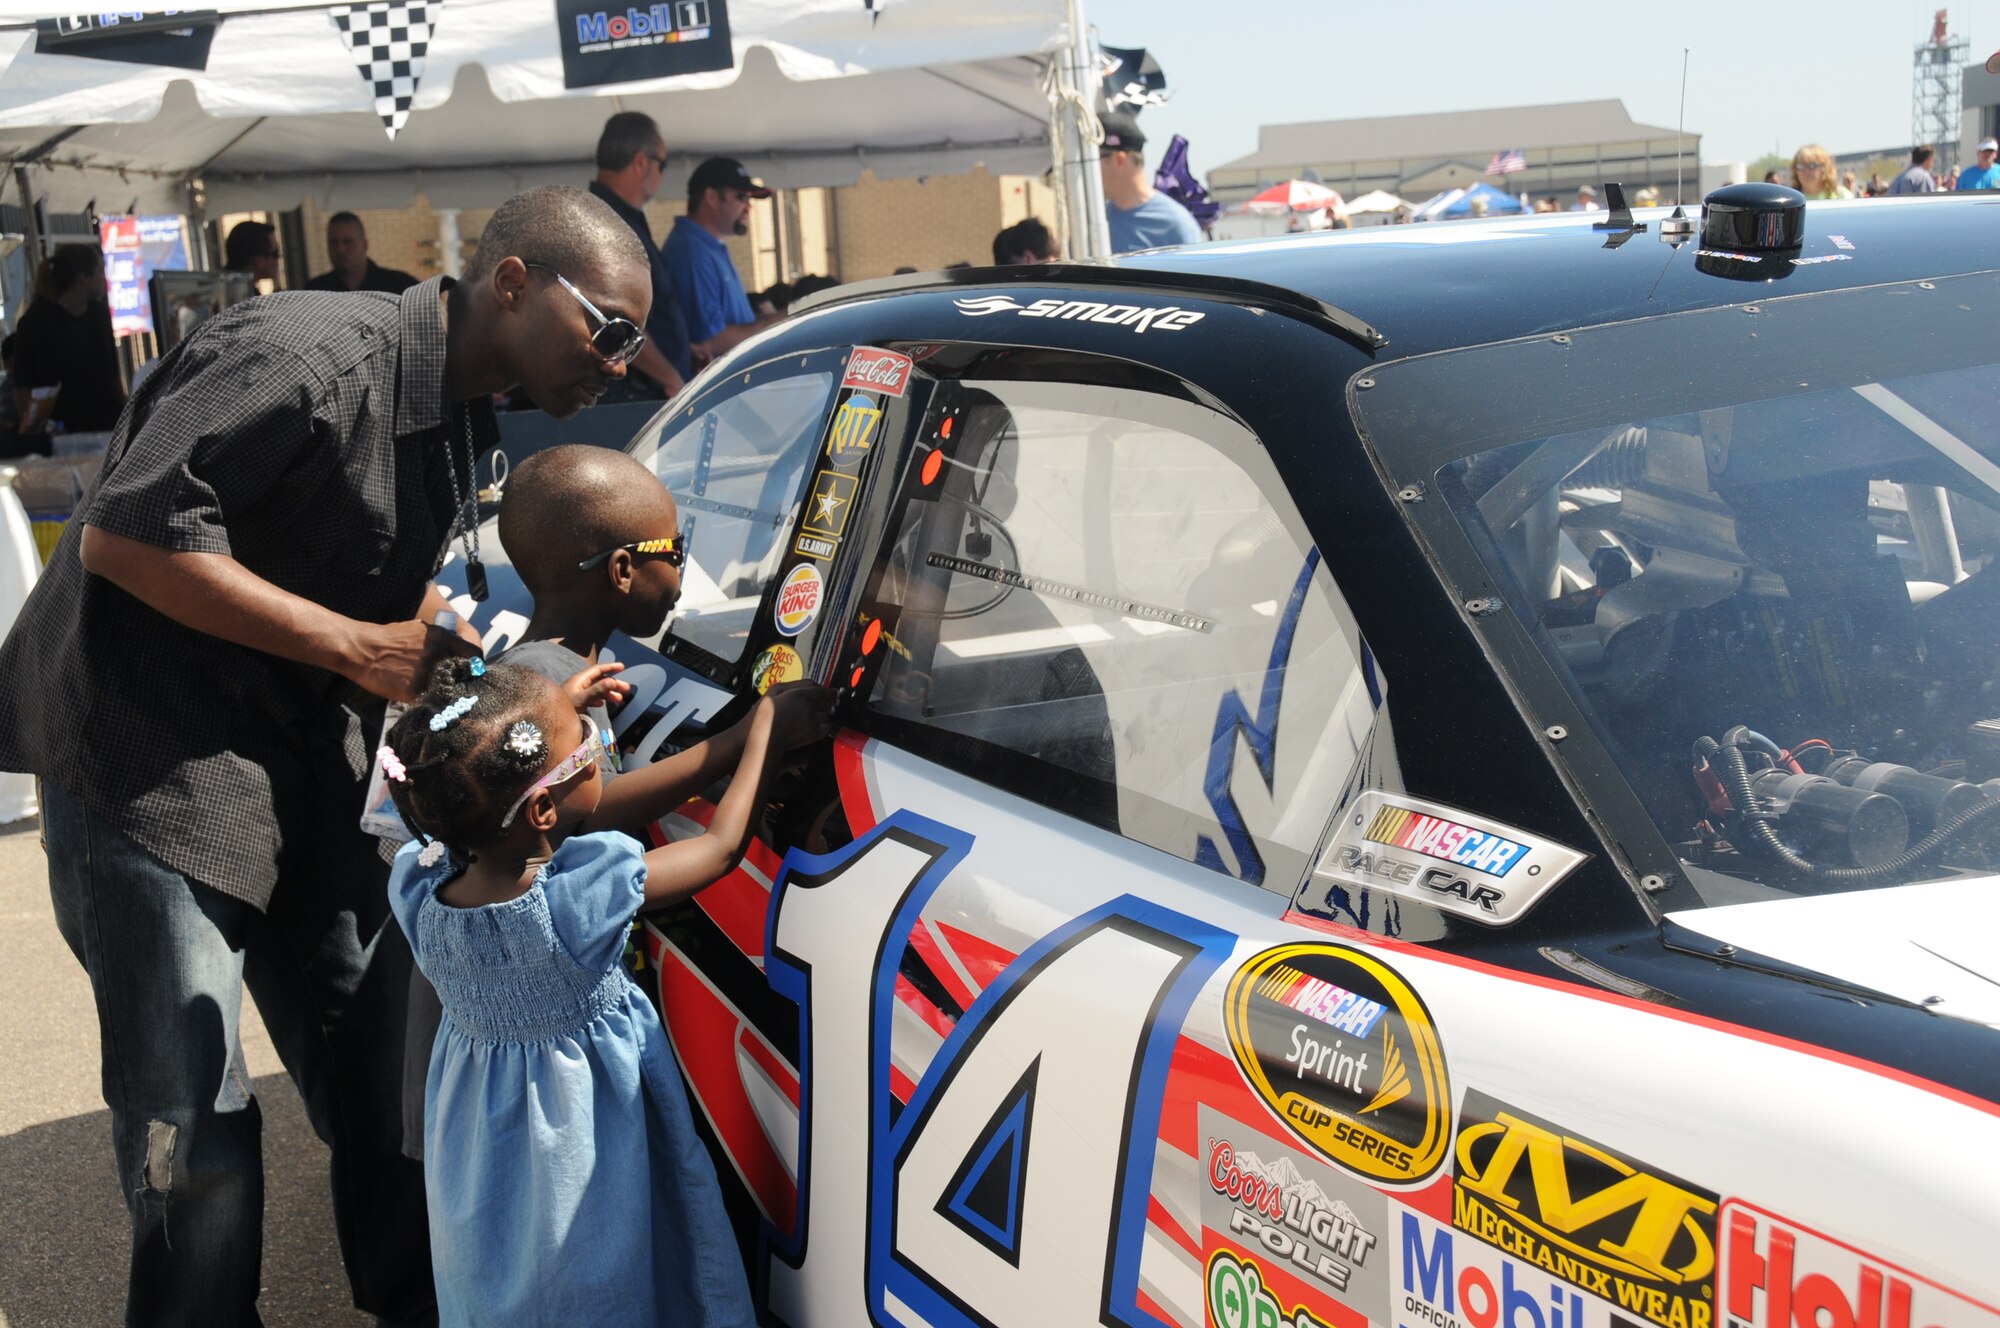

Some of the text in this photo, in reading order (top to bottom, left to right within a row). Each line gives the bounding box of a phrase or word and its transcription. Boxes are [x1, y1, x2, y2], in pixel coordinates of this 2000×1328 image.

[576, 3, 671, 43] Mobil
[847, 353, 907, 387] Coca-Cola
[826, 403, 881, 456] RITZ
[778, 594, 817, 617] KING
[783, 581, 819, 599] BURGER
[769, 663, 785, 677] Pro
[772, 647, 795, 664] Bass
[1403, 815, 1518, 874] NASCAR
[1329, 845, 1505, 916] RACE CAR
[1290, 978, 1380, 1038] NASCAR
[756, 808, 1239, 1328] 14
[1285, 1024, 1368, 1094] Sprint
[1287, 1100, 1331, 1129] CUP
[1333, 1121, 1413, 1172] SERIES
[1208, 1137, 1376, 1267] Coors LIGHT
[1230, 1207, 1351, 1293] POLE
[1453, 1184, 1711, 1328] MECHANIX WEAR
